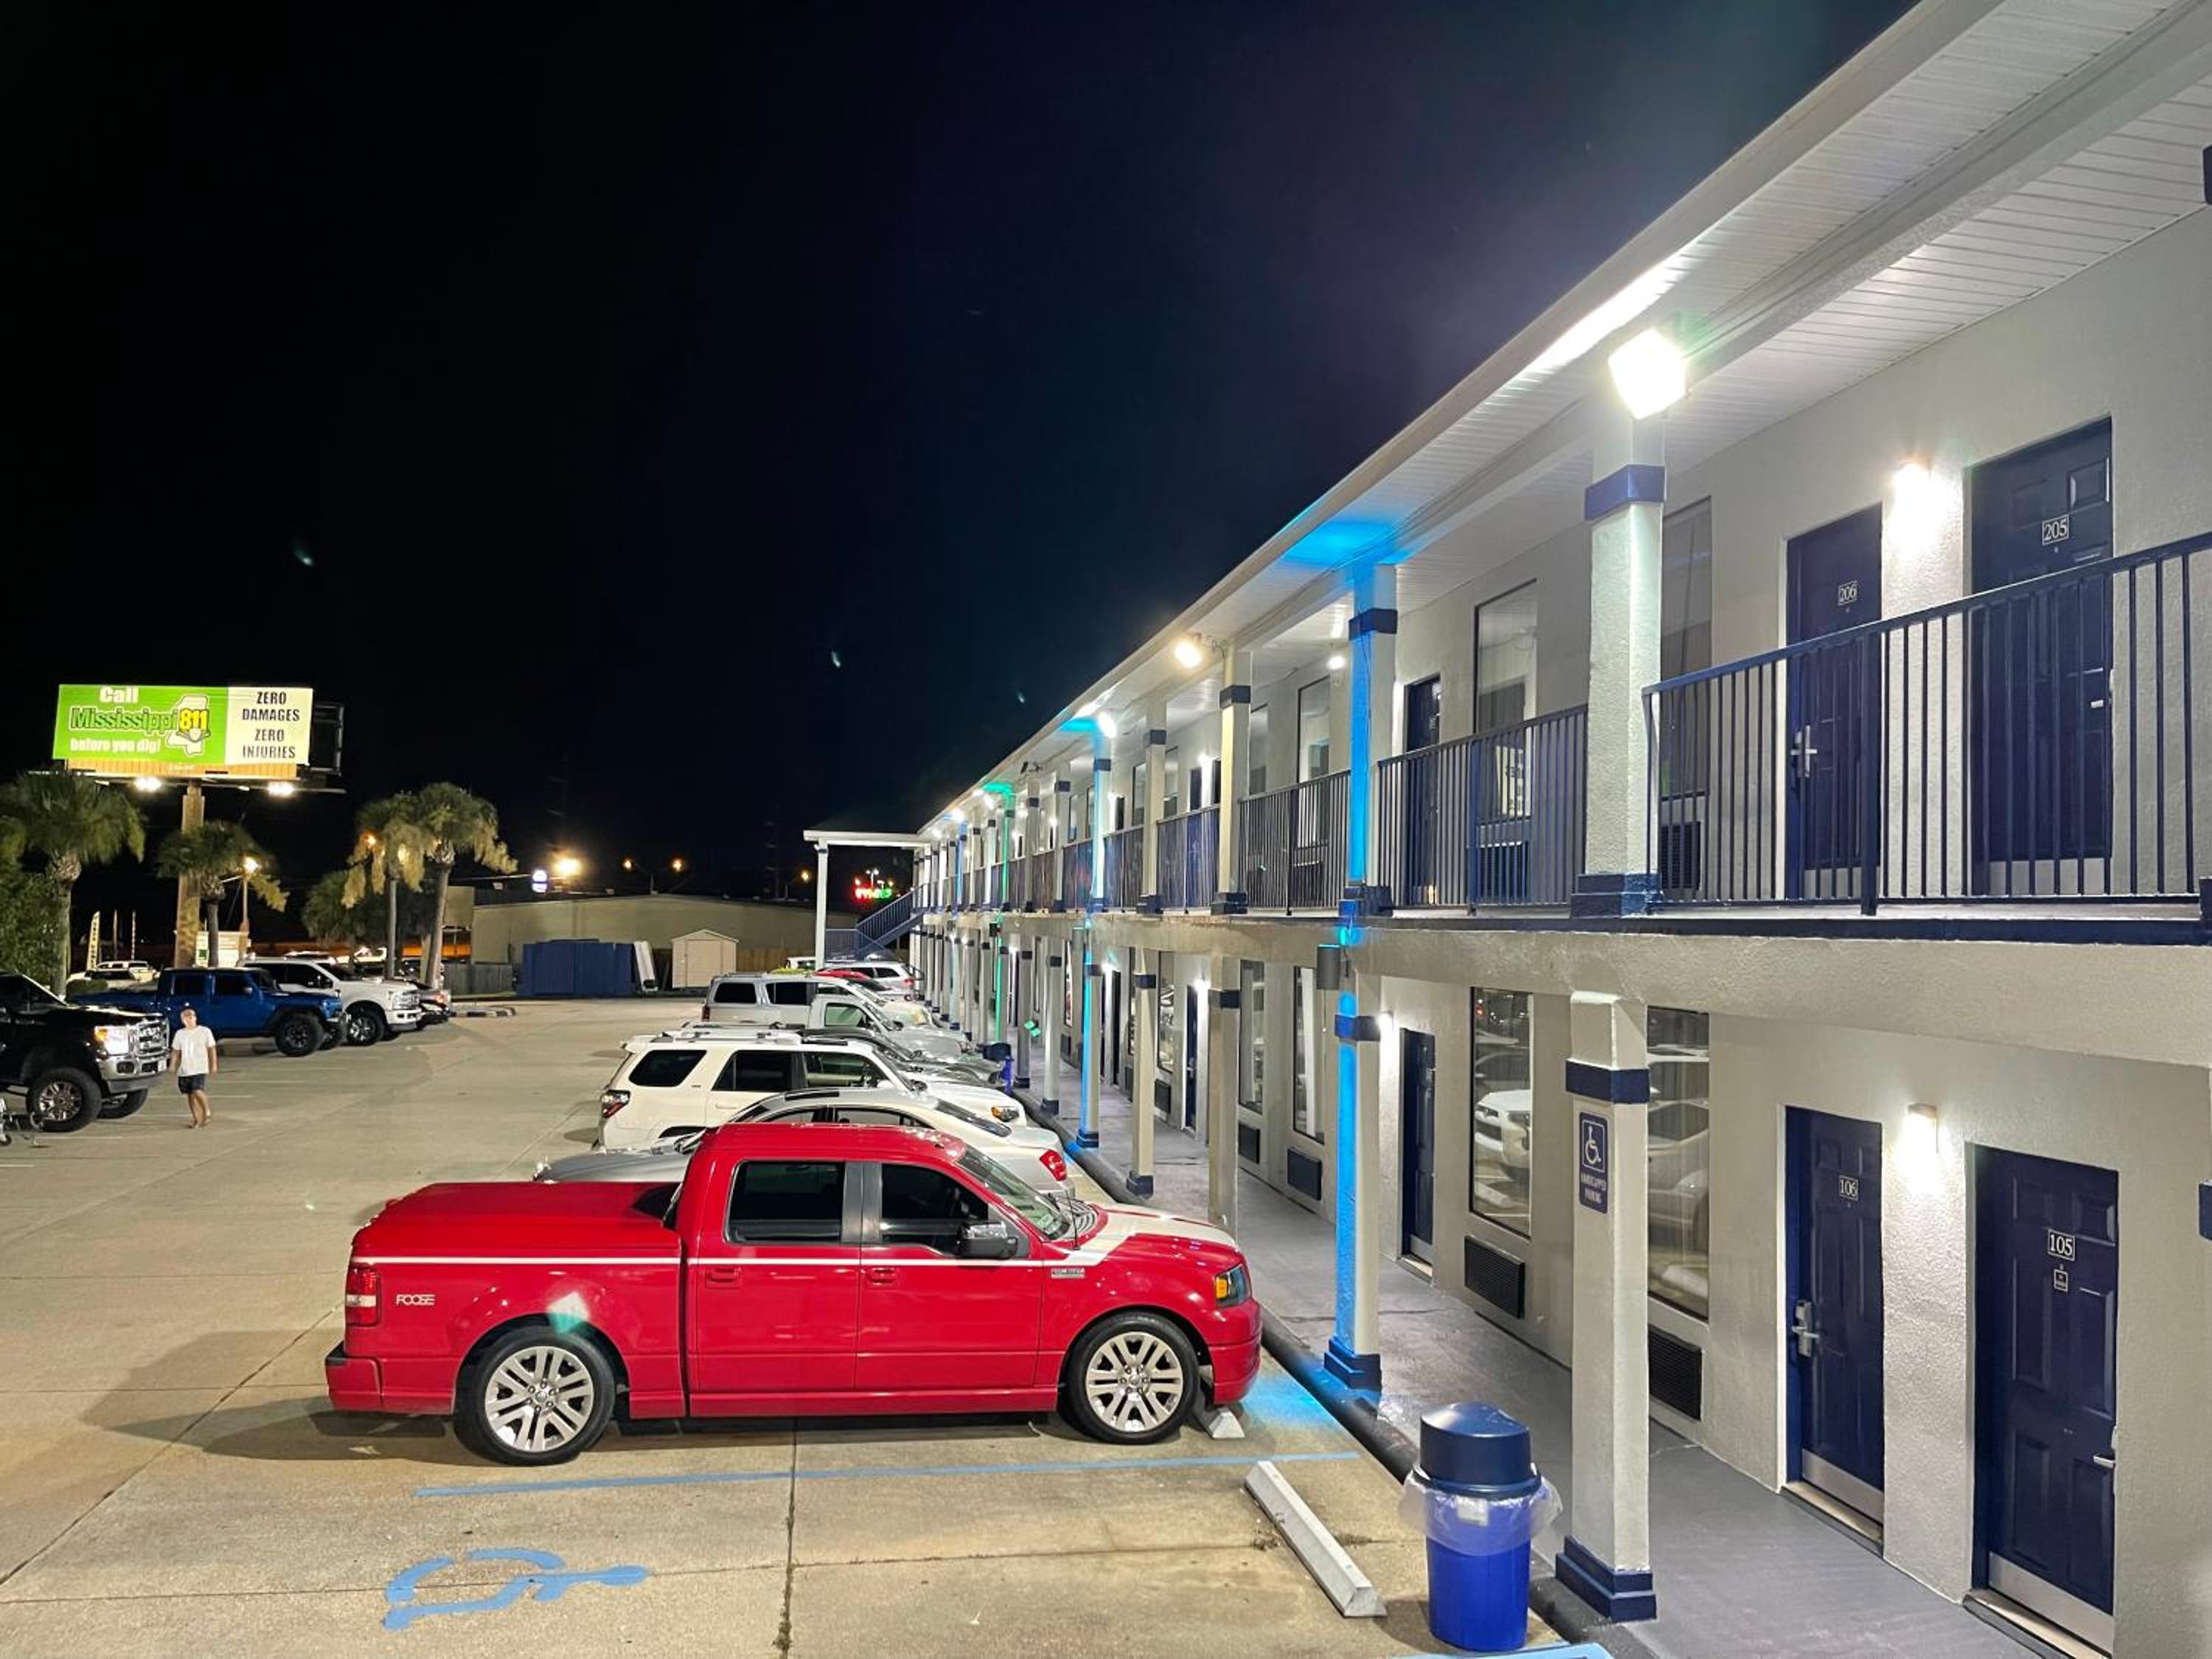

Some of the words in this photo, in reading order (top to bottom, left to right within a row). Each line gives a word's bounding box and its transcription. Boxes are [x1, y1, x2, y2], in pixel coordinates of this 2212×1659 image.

[2045, 518, 2067, 540] 205
[1840, 583, 1857, 602] 206
[100, 686, 139, 703] Call
[257, 692, 287, 705] ZERO
[71, 706, 178, 734] Mississippi
[178, 708, 209, 731] 811
[242, 709, 300, 722] DAMAGES
[254, 728, 285, 742] ZERO
[243, 745, 296, 759] INJURIES
[1840, 1179, 1857, 1197] 106
[2050, 1234, 2073, 1256] 105
[396, 1294, 436, 1306] FOOSE
